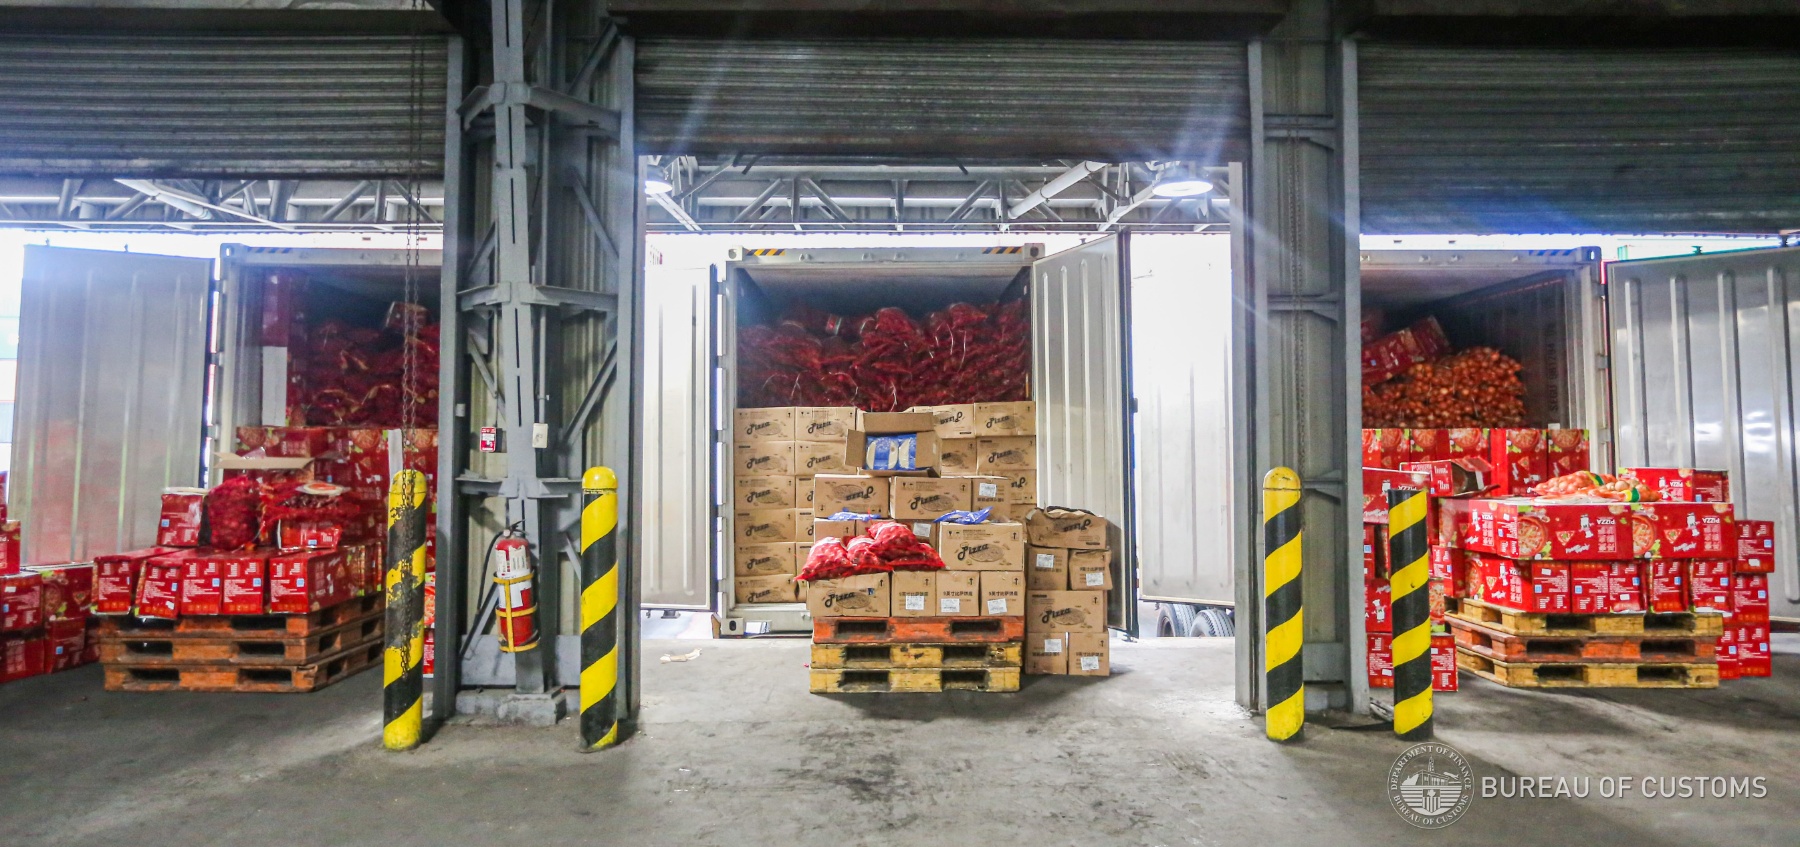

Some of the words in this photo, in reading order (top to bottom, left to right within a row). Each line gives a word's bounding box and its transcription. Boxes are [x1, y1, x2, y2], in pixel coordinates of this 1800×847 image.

[940, 411, 963, 424] Pizza
[986, 416, 1010, 428] Pizza
[746, 422, 770, 435] Pizza
[808, 421, 831, 434] Pizza
[746, 456, 770, 469] Pizza
[807, 455, 831, 468] Pizza
[988, 450, 1012, 463] Pizza
[747, 490, 770, 502] Pizza
[846, 486, 873, 500] Pizza
[910, 495, 939, 510] Pizza
[746, 524, 769, 536] Pizza
[1064, 519, 1091, 532] Pizza
[958, 544, 988, 560] Pizza
[747, 557, 770, 569] Pizza
[748, 590, 770, 603] Pizza
[824, 592, 855, 607] Pizza
[1042, 608, 1070, 623] Pizza
